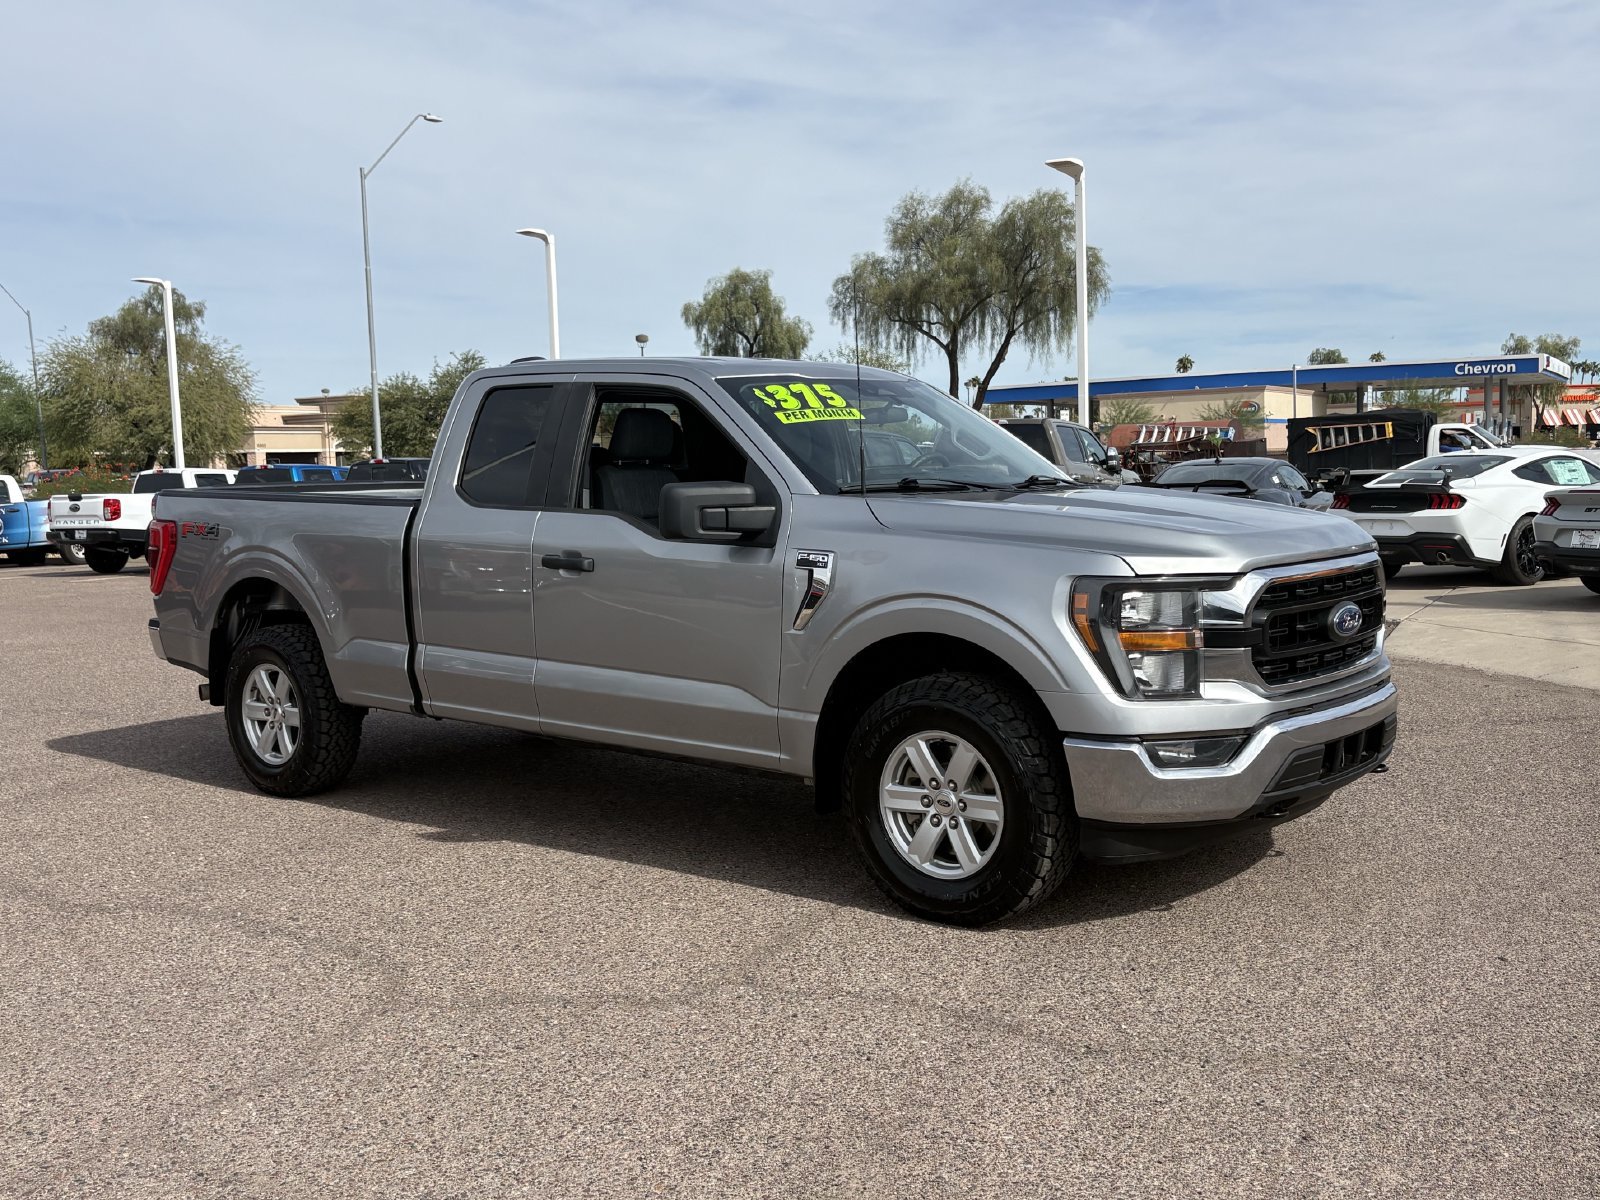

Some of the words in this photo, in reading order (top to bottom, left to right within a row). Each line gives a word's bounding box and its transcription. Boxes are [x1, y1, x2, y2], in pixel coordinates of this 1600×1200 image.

[1455, 363, 1516, 375] Chevron
[753, 384, 847, 410] $375
[782, 410, 810, 421] PER
[811, 408, 856, 419] MONTH
[181, 521, 220, 538] FX4
[797, 553, 828, 563] F-150
